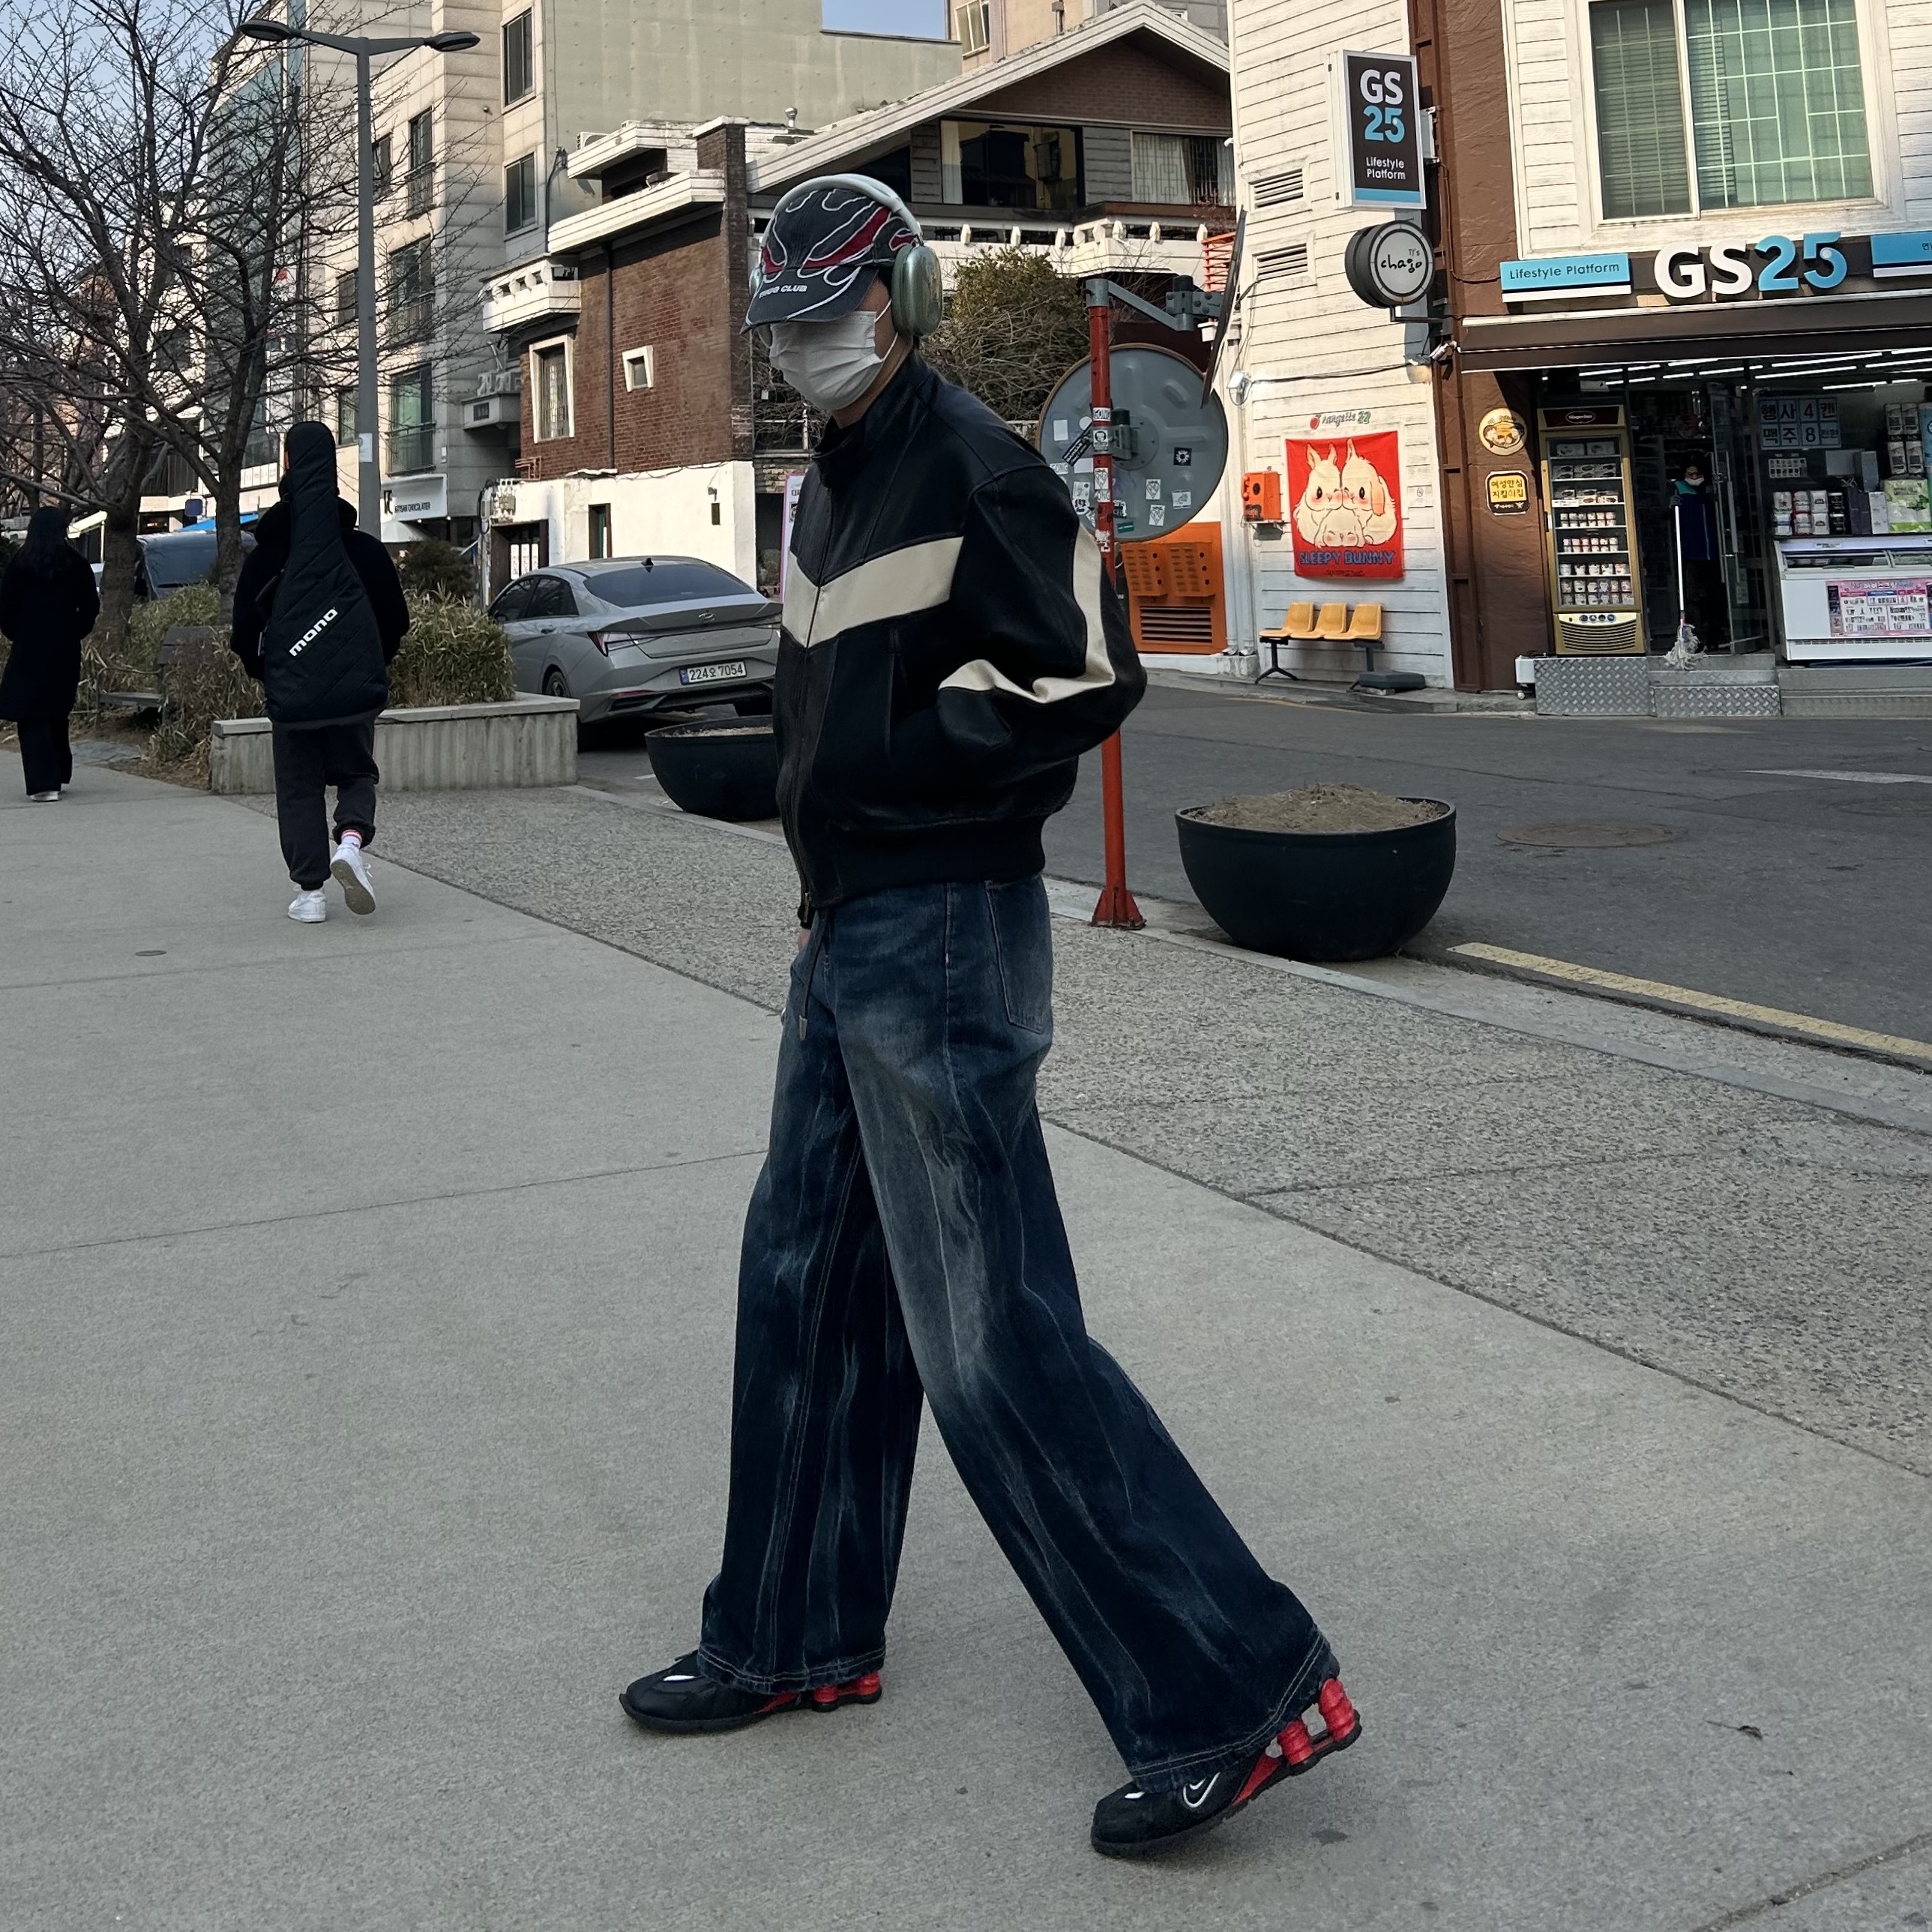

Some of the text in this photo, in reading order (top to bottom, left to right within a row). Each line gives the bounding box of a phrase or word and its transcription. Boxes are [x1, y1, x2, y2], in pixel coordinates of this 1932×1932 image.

[1360, 69, 1403, 105] GS
[1363, 105, 1405, 143] 25
[1366, 157, 1404, 170] Lifestyle
[1367, 169, 1406, 180] Platform
[1381, 254, 1422, 273] chago
[1510, 263, 1619, 280] Lifestyle Platform
[1653, 231, 1848, 298] GS25
[1299, 550, 1395, 565] SLEEPY BUNNY
[289, 608, 338, 657] mono
[717, 663, 743, 676] 7054
